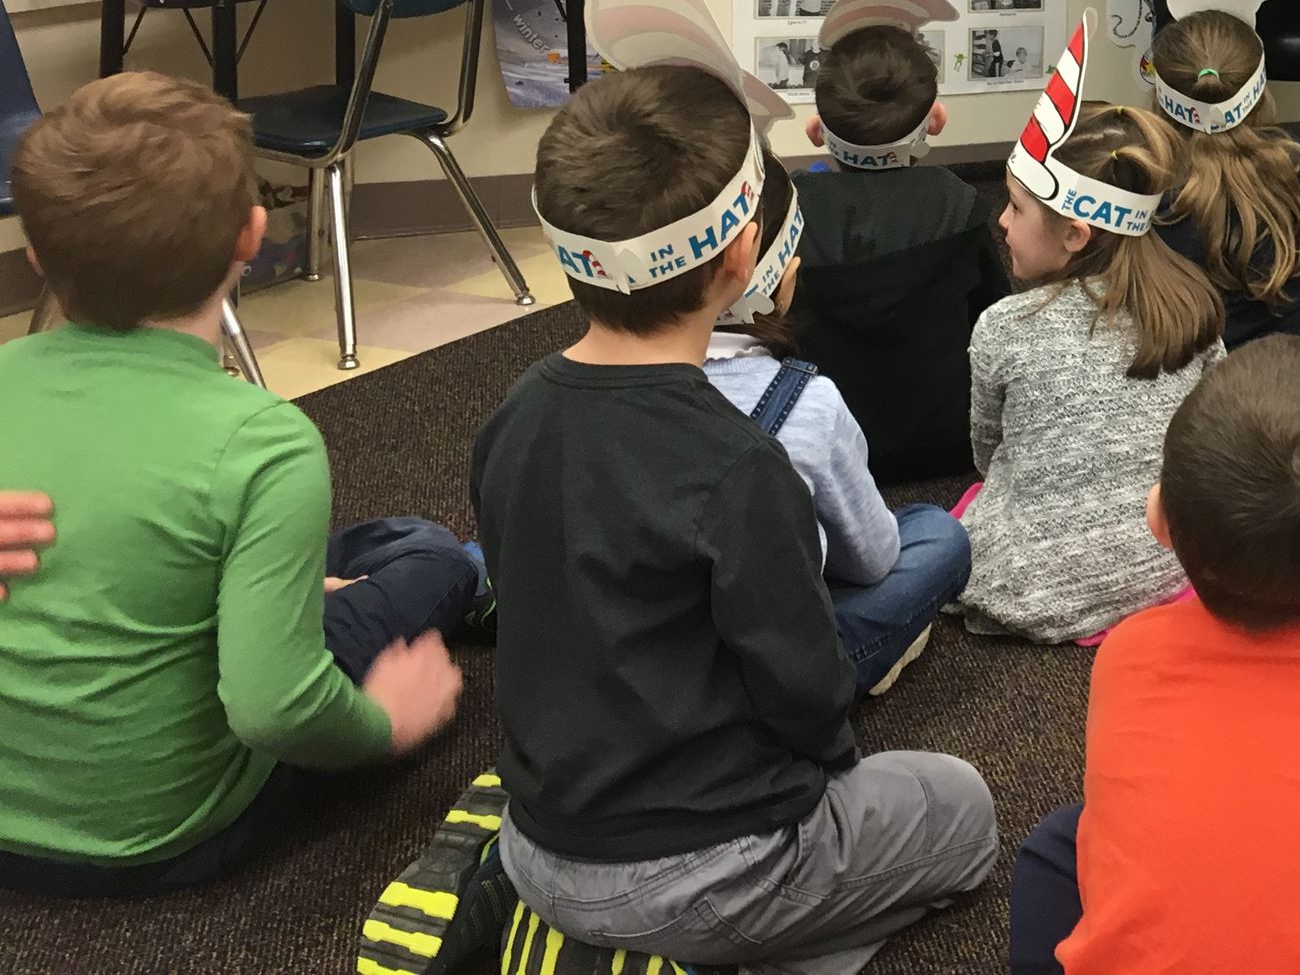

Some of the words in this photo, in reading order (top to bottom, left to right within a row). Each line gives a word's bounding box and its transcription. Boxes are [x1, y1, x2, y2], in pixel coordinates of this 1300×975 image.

[512, 13, 549, 52] winter
[1164, 95, 1194, 124] HAT
[843, 150, 890, 166] HAT
[1061, 188, 1077, 211] THE
[1073, 194, 1132, 228] CAT
[1134, 209, 1147, 220] IN
[688, 193, 752, 260] HAT
[778, 208, 804, 269] HAT
[650, 243, 673, 262] IN
[649, 256, 687, 279] THE
